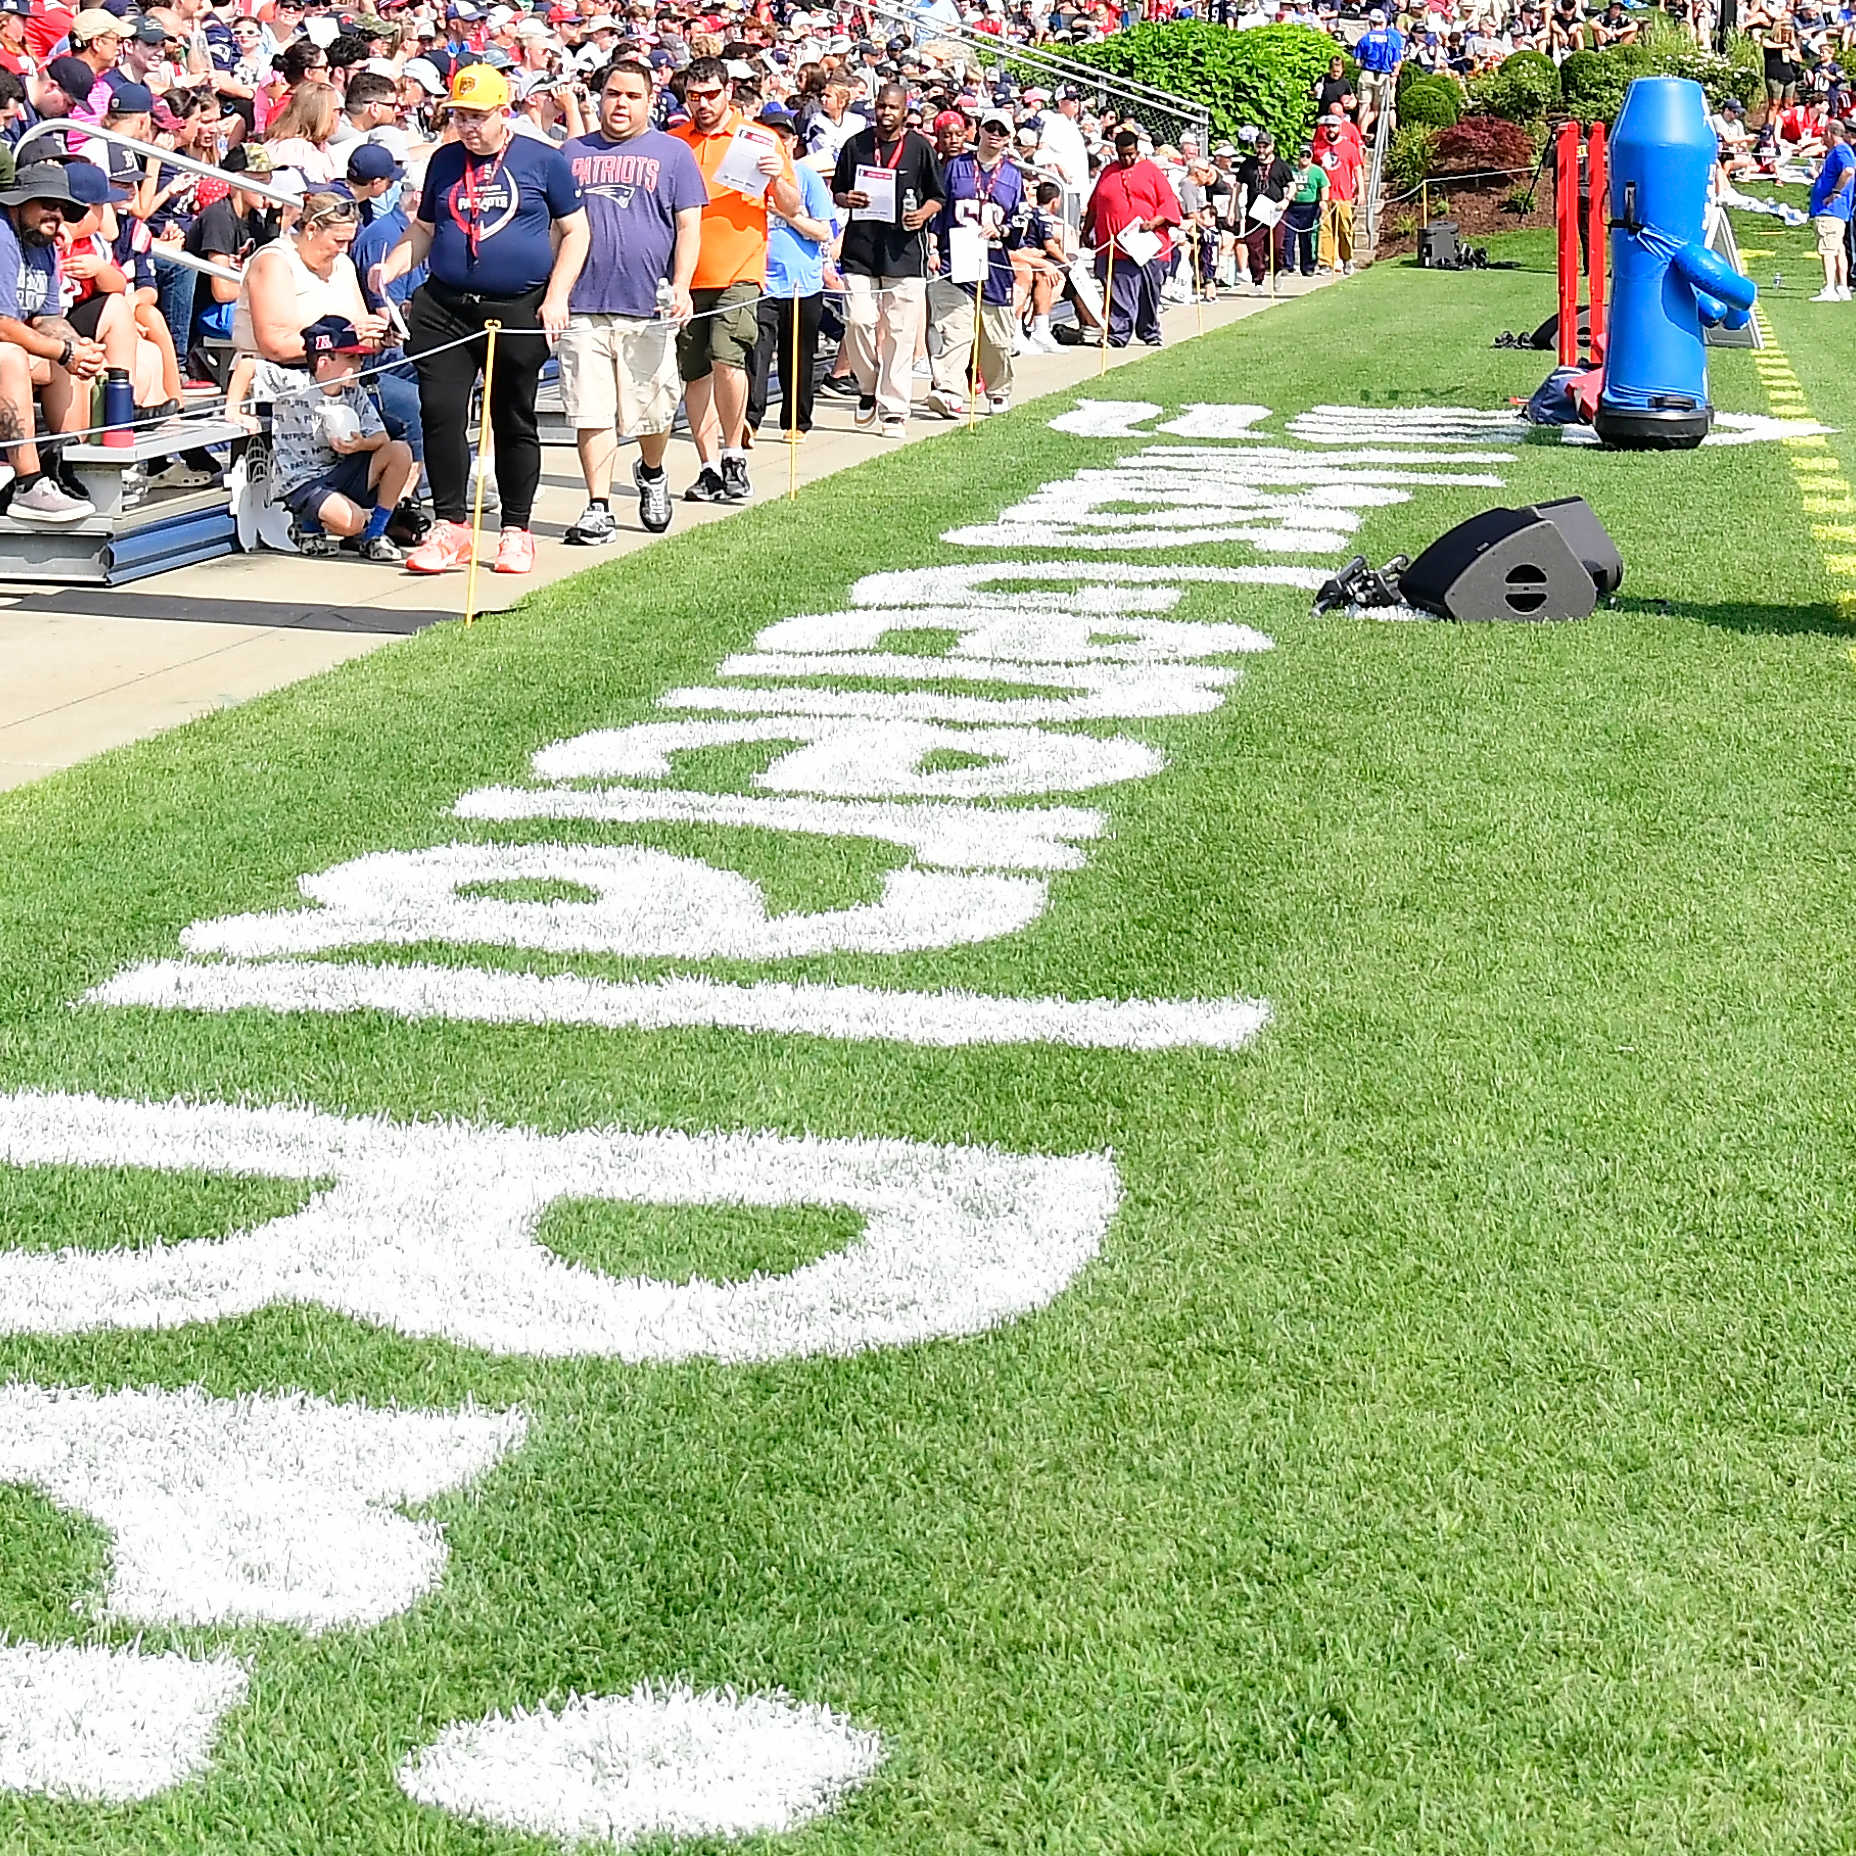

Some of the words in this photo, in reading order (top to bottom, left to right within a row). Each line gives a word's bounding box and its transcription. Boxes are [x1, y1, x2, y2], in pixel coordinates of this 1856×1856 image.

[572, 154, 661, 194] PATRIOTS
[940, 444, 1517, 554] Mass
[79, 558, 1440, 1050] General
